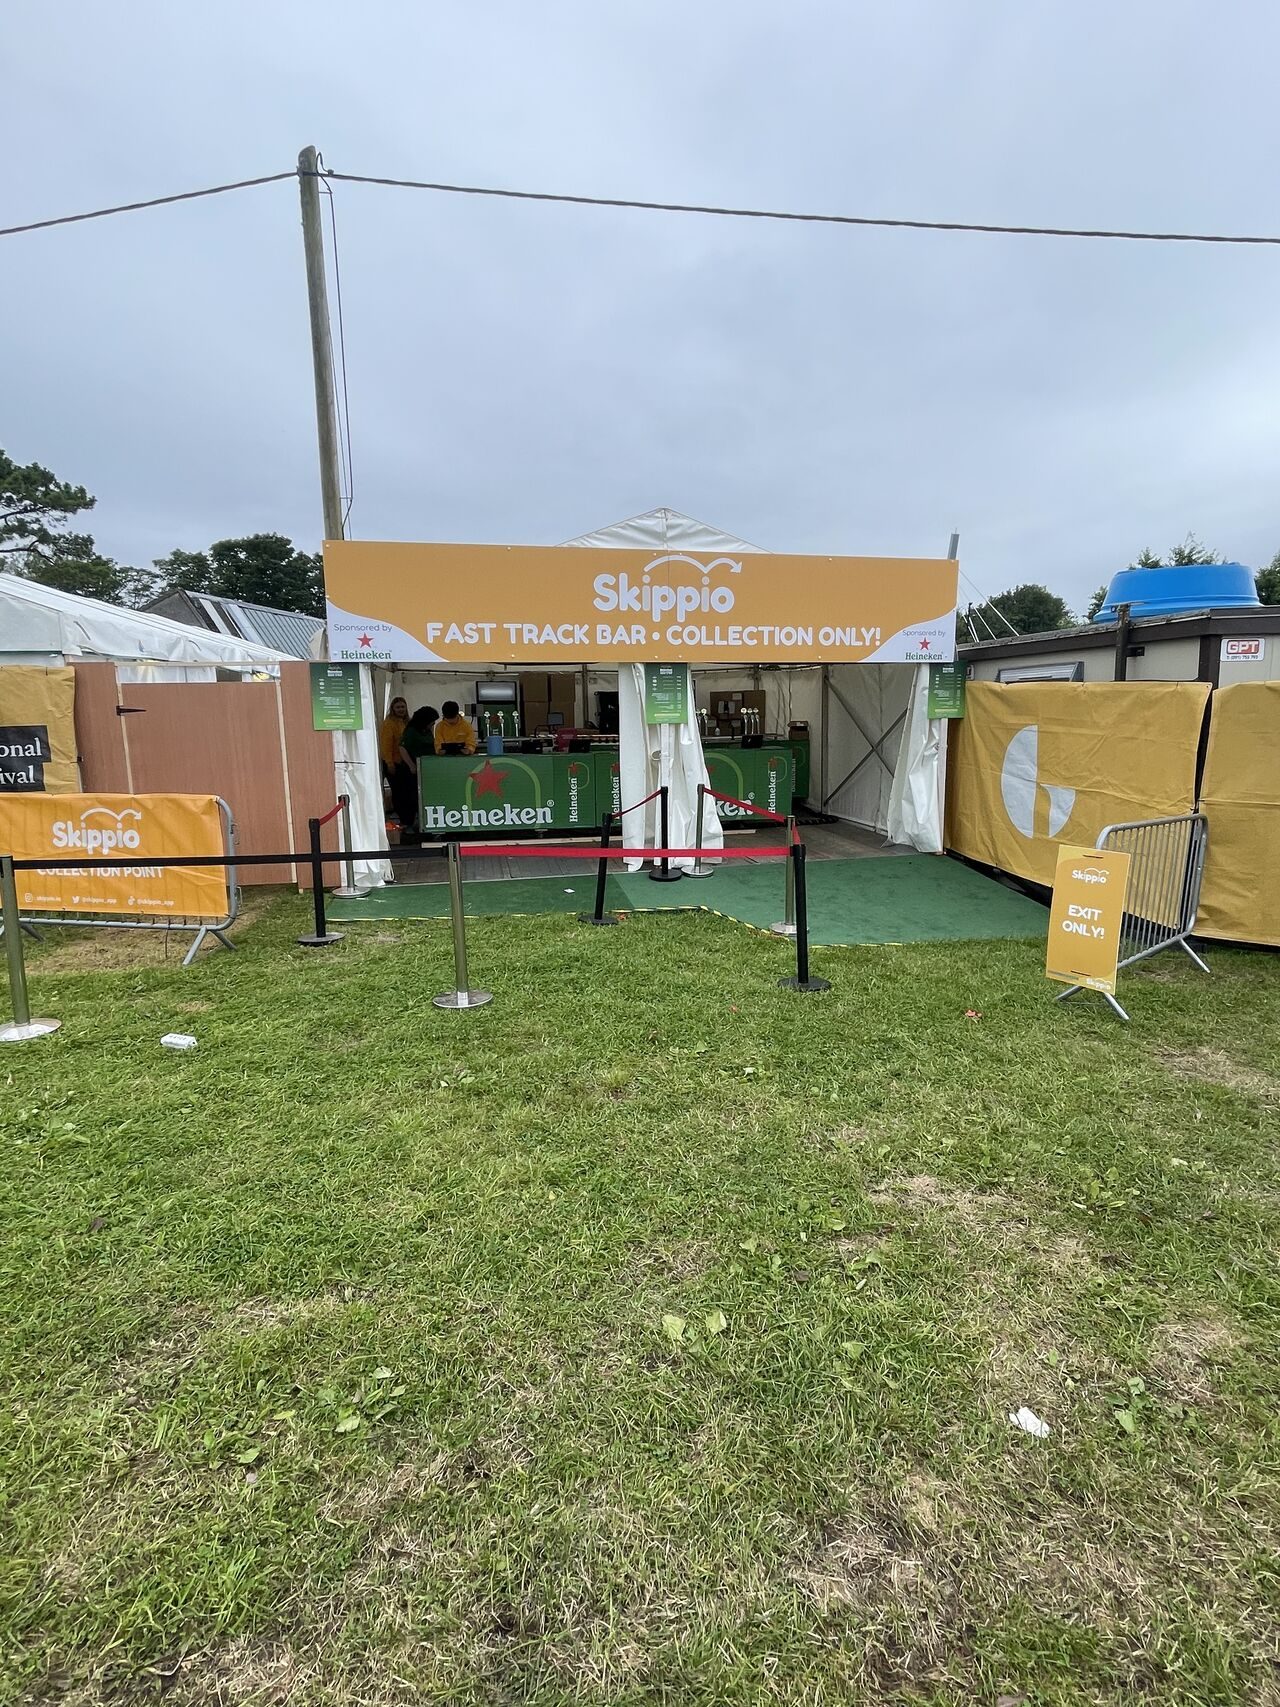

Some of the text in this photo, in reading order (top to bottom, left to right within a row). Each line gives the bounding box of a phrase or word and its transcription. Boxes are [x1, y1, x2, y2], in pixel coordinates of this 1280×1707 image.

[593, 572, 735, 622] Skippio
[333, 624, 393, 632] Sponsored by
[426, 623, 881, 646] FAST TRACK BAR COLLECTION ONLY!
[341, 650, 392, 659] Heineken
[905, 652, 943, 660] Heineken
[1227, 641, 1259, 653] GPT
[569, 776, 578, 822] Heineken
[611, 776, 620, 819] eineken
[52, 820, 141, 855] Skippio
[1071, 869, 1107, 884] Skippio
[1068, 904, 1103, 921] EXIT
[1062, 920, 1105, 939] ONLY!
